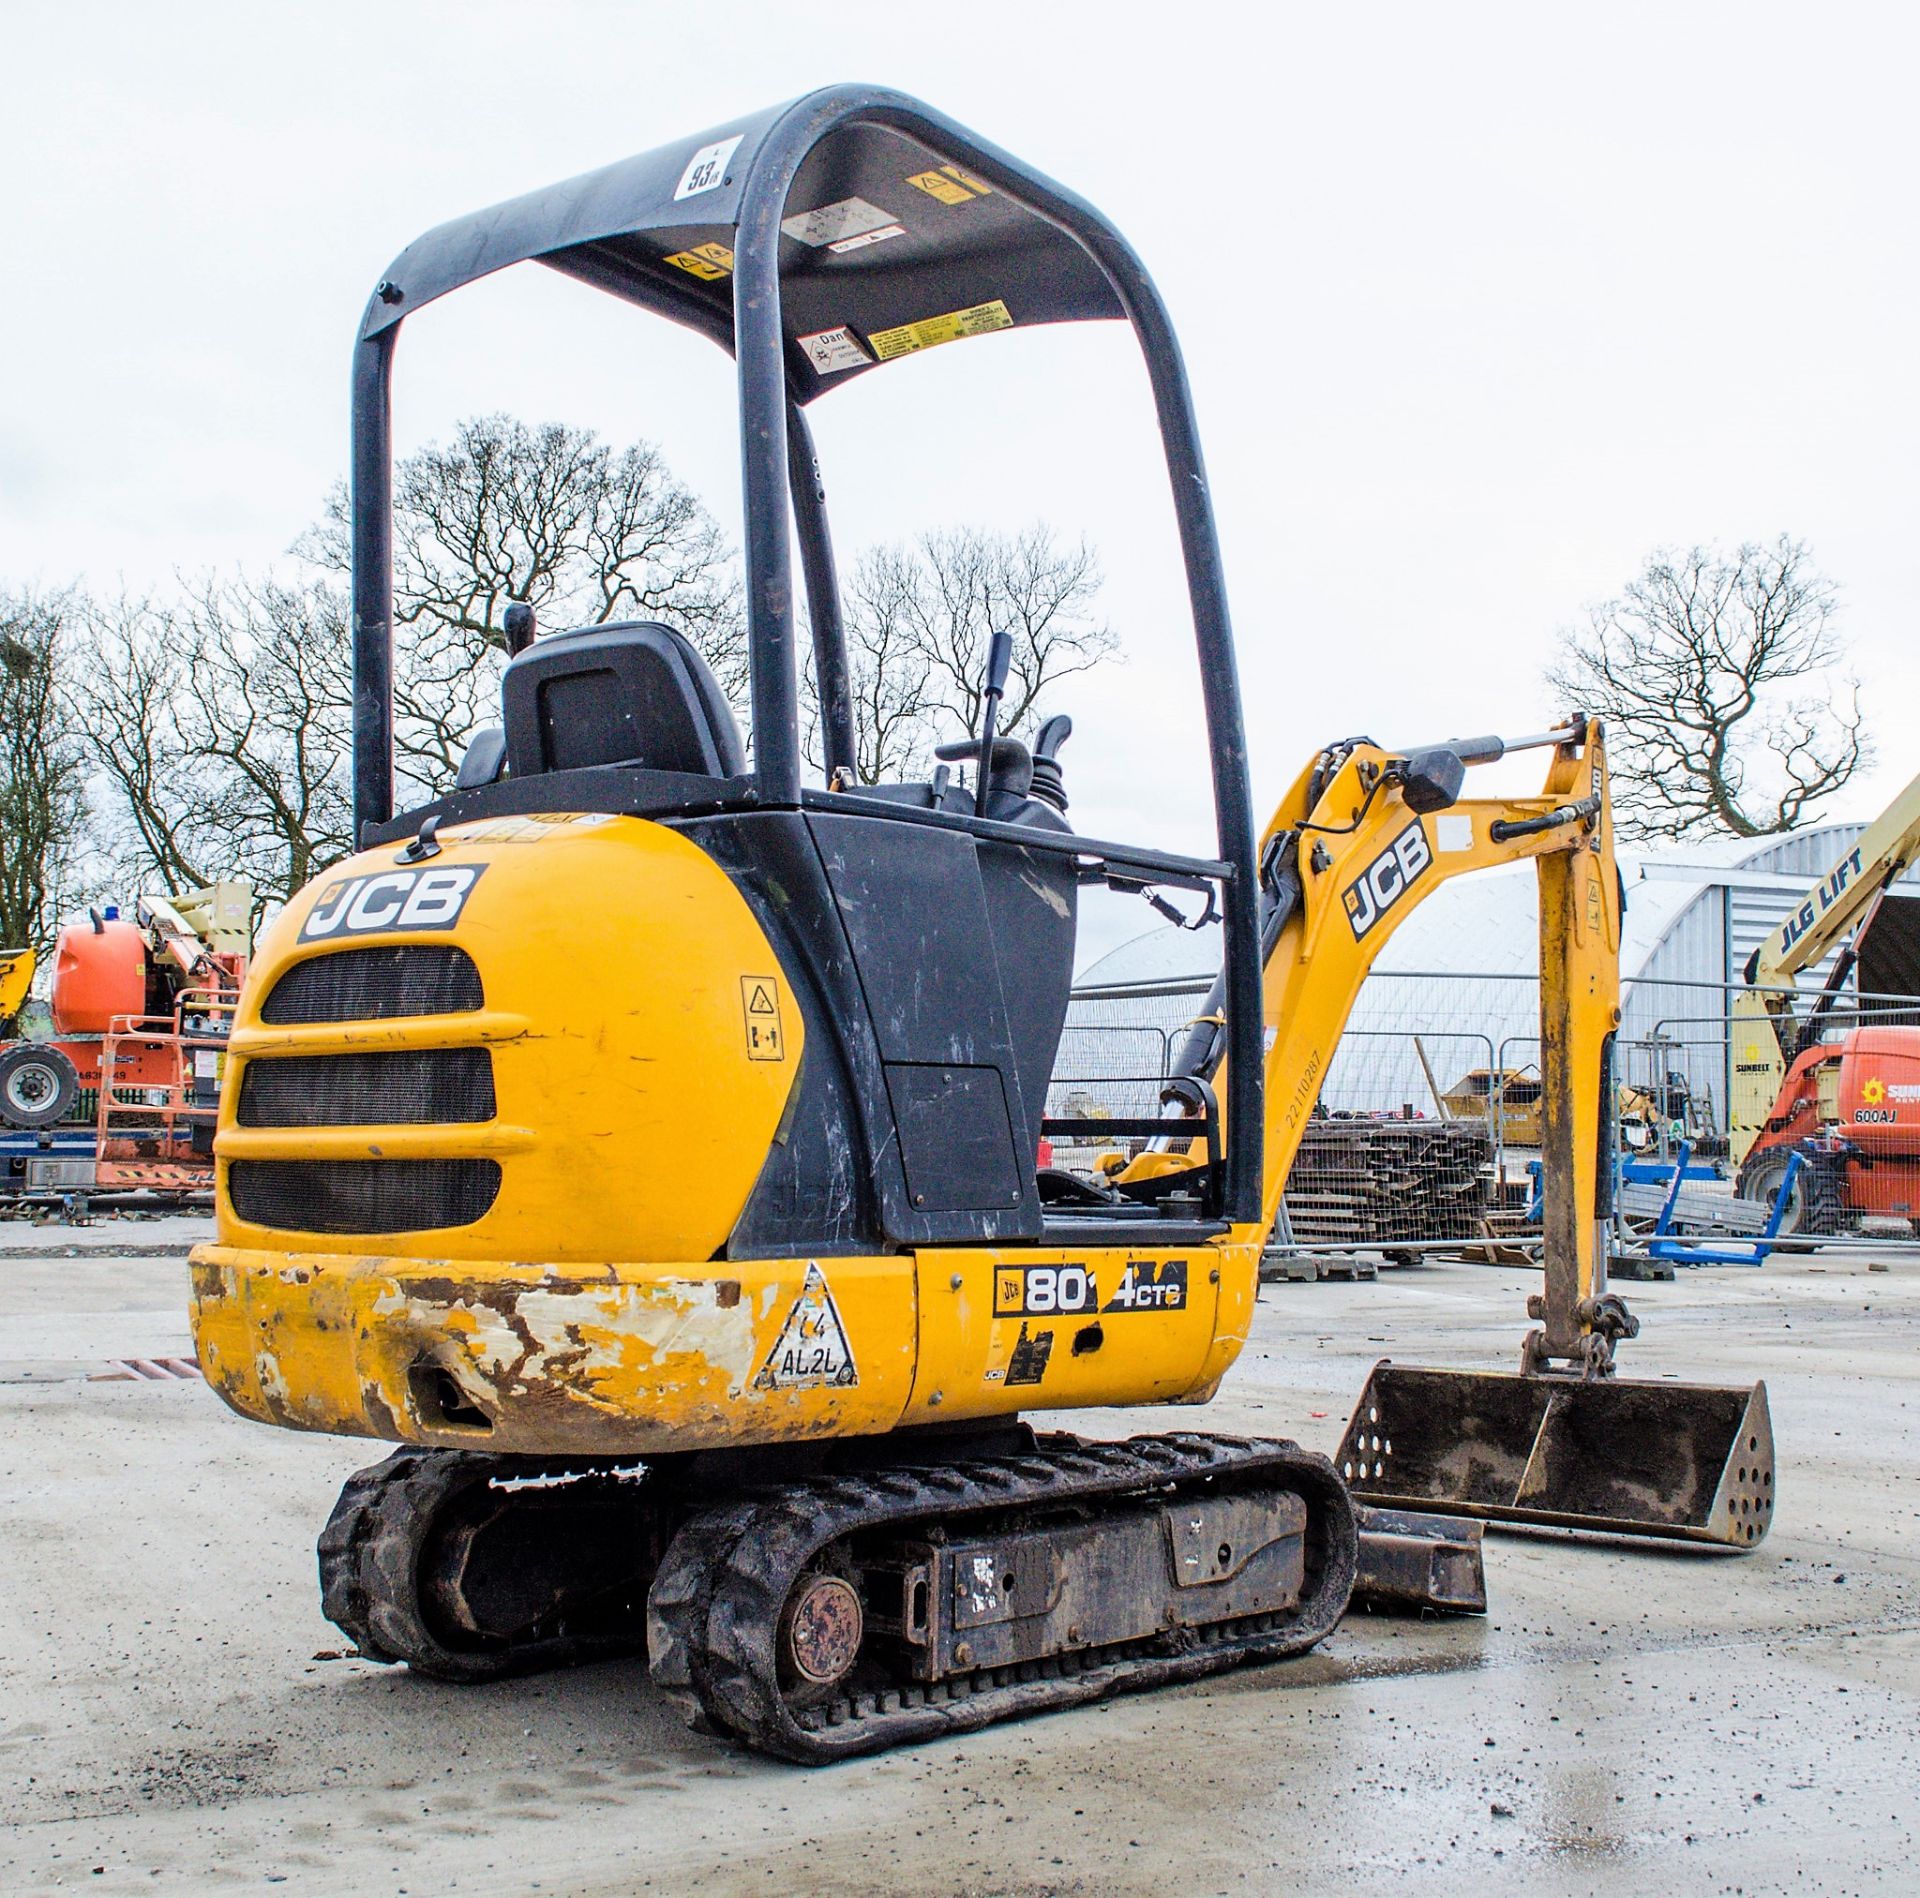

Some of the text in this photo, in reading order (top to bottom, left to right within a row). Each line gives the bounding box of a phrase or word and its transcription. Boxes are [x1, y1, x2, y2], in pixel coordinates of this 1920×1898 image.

[687, 161, 716, 191] 93
[1352, 824, 1430, 934] JCB
[305, 868, 476, 936] JCB
[1781, 847, 1861, 955] JLG LIFT
[1736, 1063, 1770, 1073] SUNBELT
[1854, 1109, 1897, 1123] 600AJ
[1003, 1281, 1020, 1301] JCB
[1026, 1267, 1135, 1312] 804
